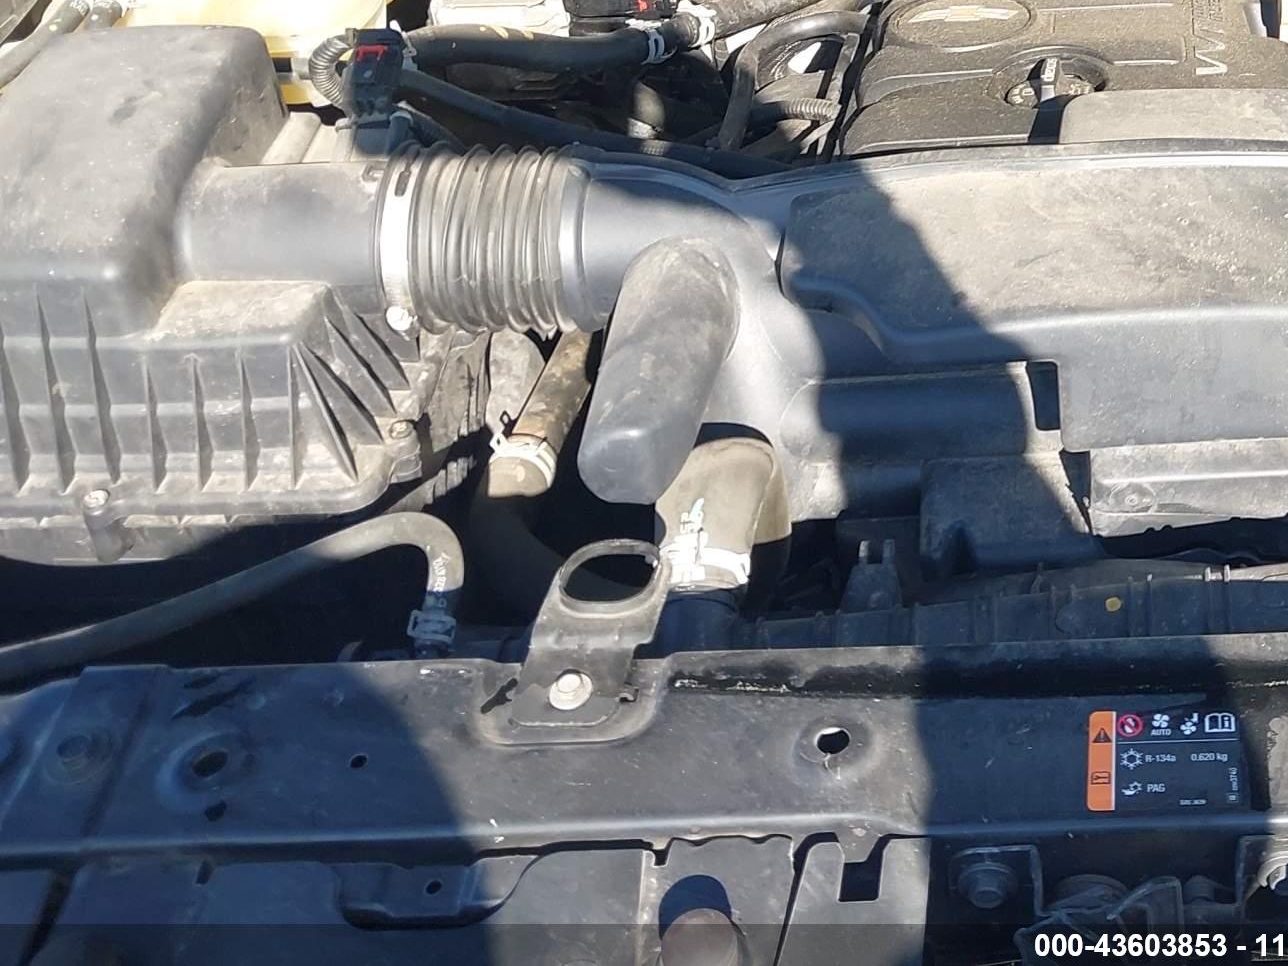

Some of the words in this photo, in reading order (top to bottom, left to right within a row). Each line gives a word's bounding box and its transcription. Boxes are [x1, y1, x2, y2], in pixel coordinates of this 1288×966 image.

[1150, 728, 1172, 736] AUTO
[1145, 753, 1177, 763] R-134a
[1190, 752, 1215, 762] 0.620
[1216, 752, 1228, 763] kg
[1147, 782, 1166, 793] PAG
